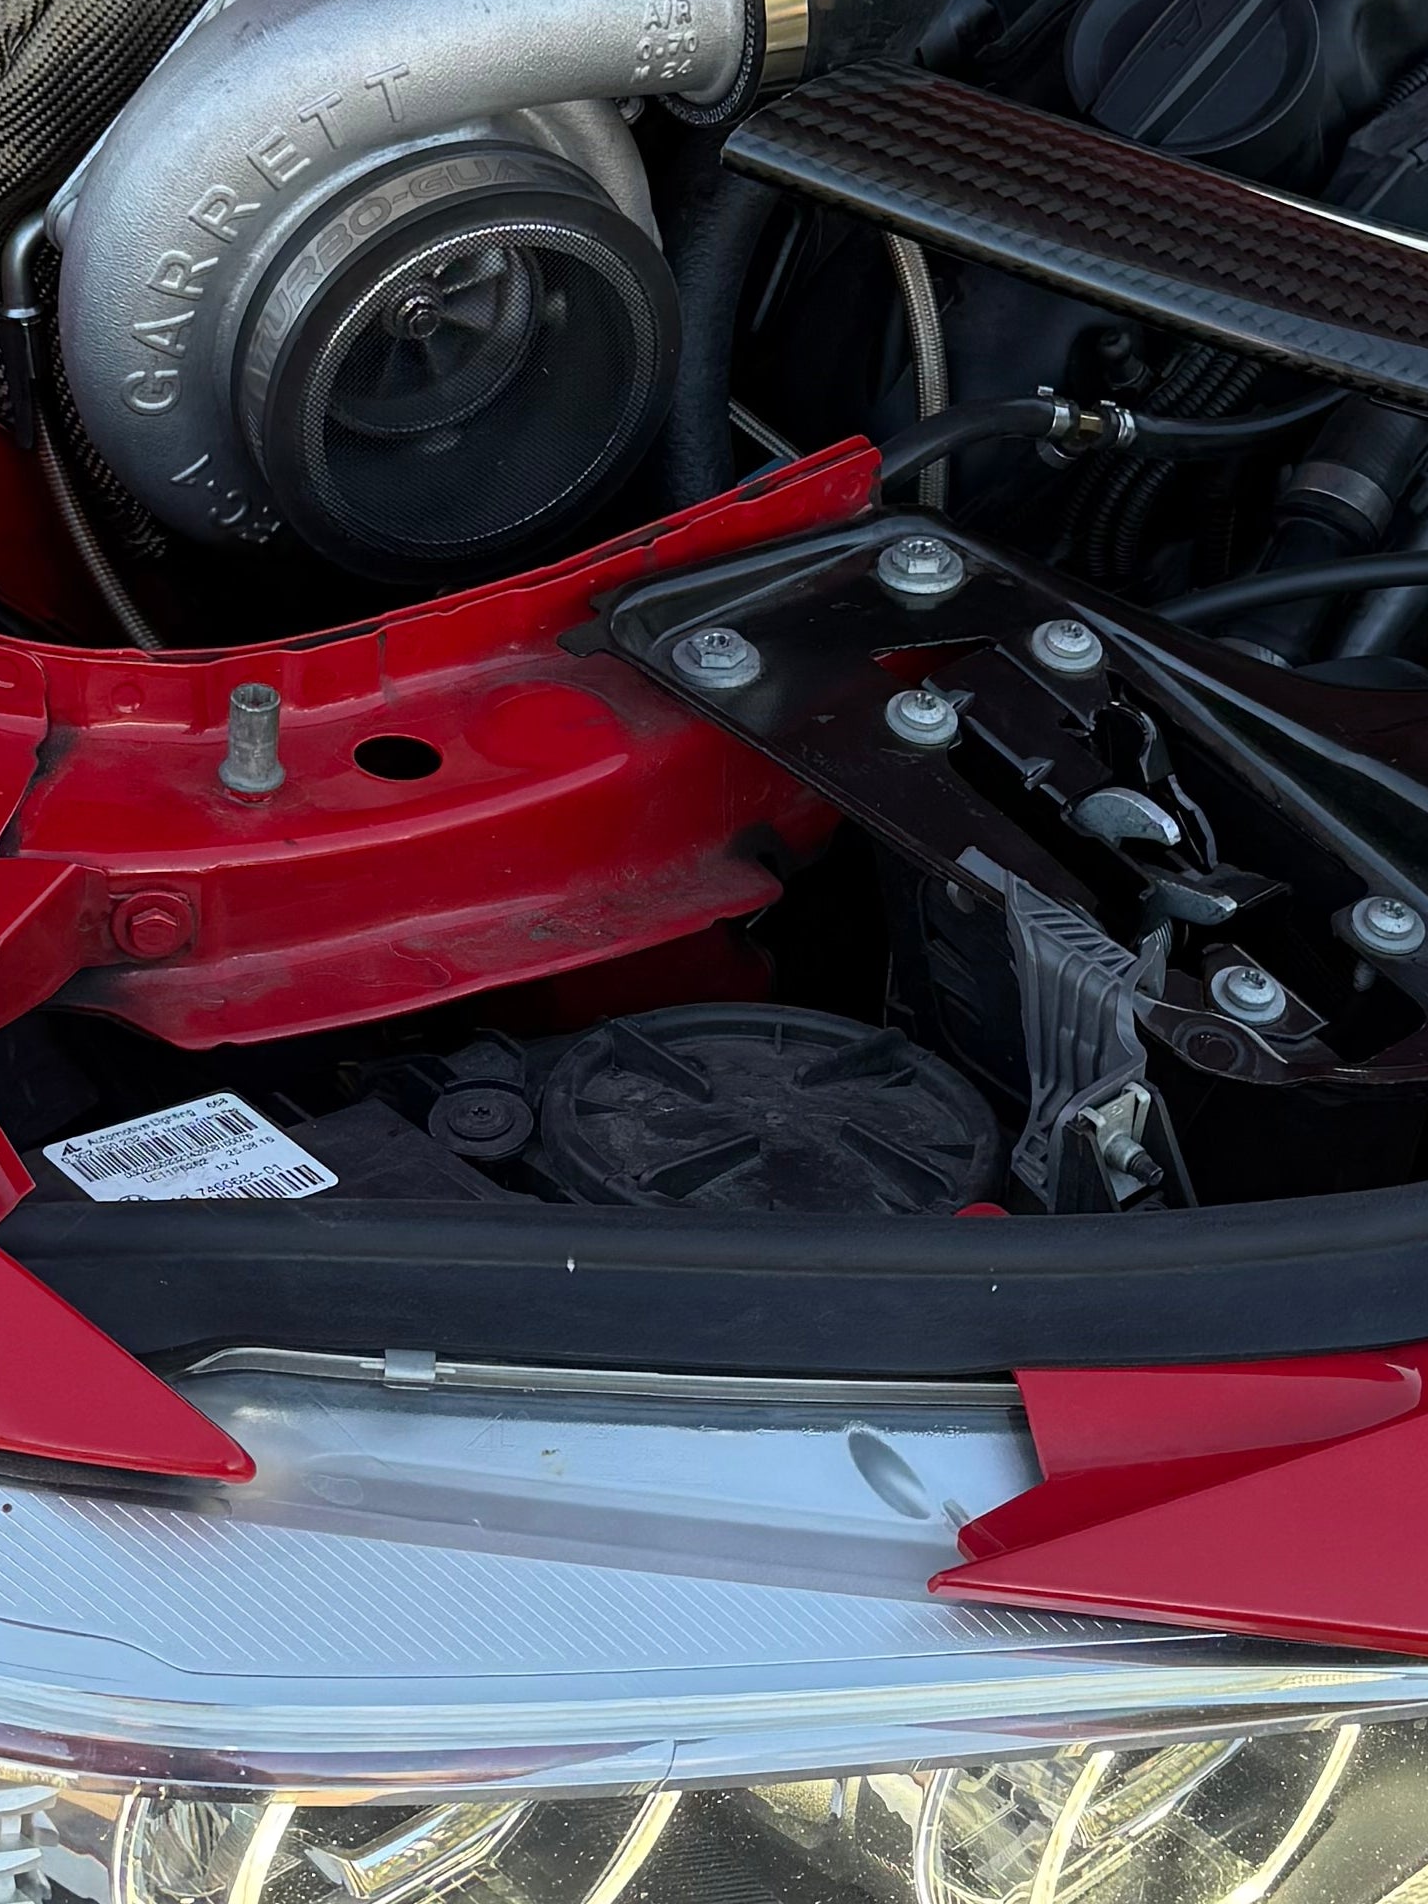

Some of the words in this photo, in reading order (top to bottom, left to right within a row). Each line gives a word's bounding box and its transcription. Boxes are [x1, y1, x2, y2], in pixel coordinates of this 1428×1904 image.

[122, 62, 410, 416] GARRETT
[246, 156, 564, 364] TURBO-GUA
[87, 1124, 149, 1146] Automotive
